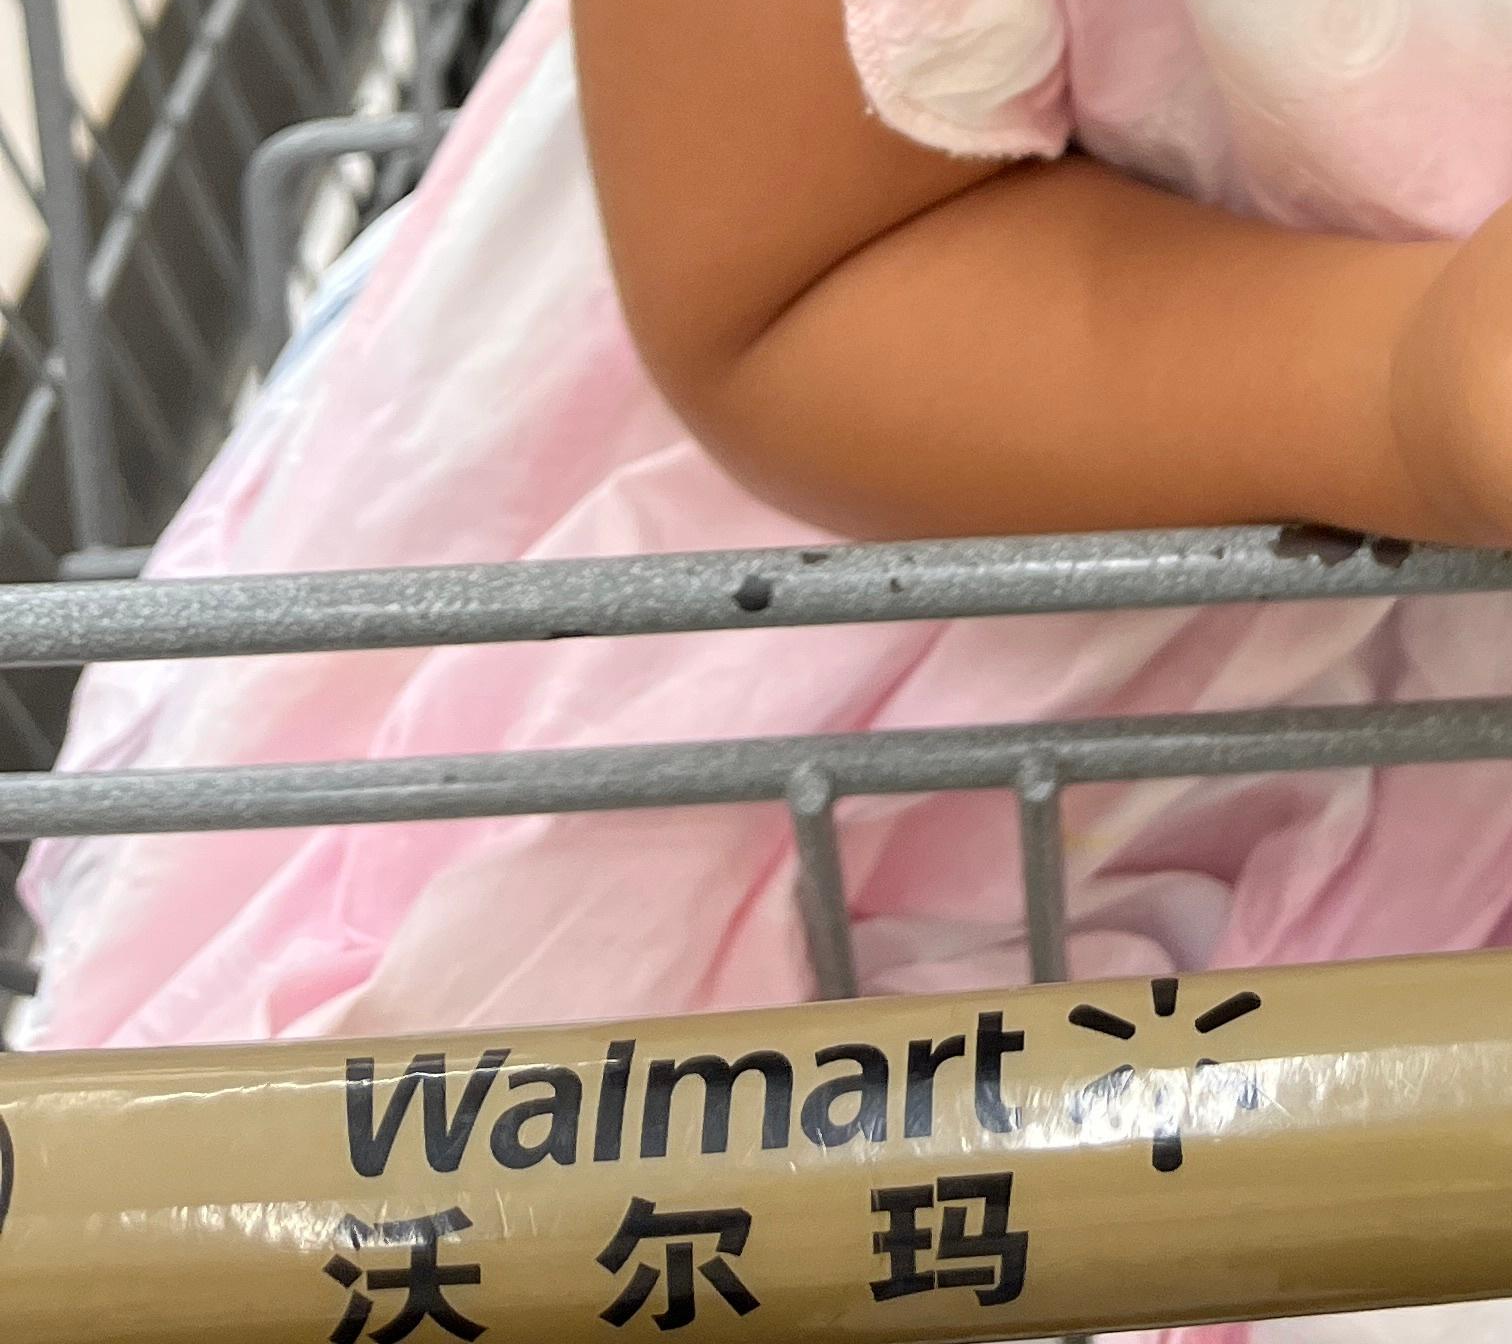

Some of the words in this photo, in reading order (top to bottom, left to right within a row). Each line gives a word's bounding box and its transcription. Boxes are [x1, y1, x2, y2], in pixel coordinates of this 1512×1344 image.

[345, 1010, 1026, 1178] Walmart
[321, 1171, 1029, 1344] 沃尔玛
